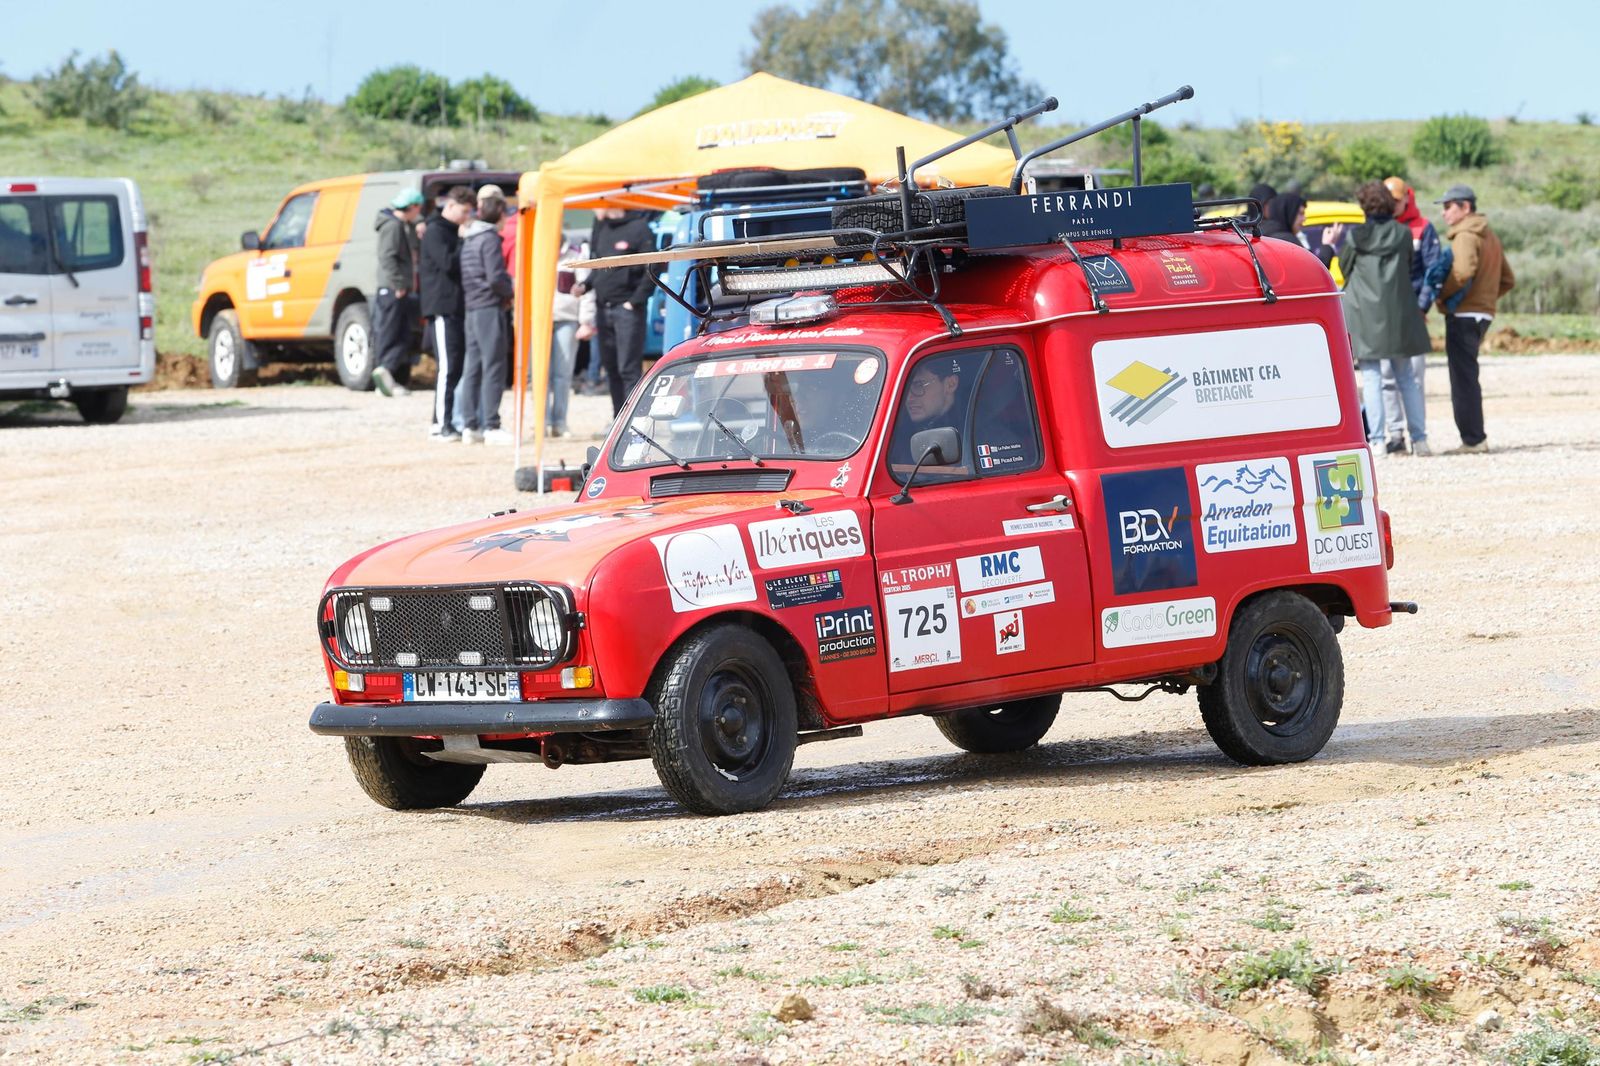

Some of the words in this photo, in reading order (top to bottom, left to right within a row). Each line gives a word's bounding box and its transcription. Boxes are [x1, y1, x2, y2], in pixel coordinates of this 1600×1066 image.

[1031, 190, 1132, 214] FERRANDI
[1072, 217, 1094, 225] PARIS
[1057, 230, 1080, 239] CAMPUS
[1090, 228, 1113, 236] RENNES
[741, 359, 782, 373] TROPHY
[1192, 366, 1255, 387] BÂTIMENT
[1258, 364, 1281, 381] CFA
[653, 376, 671, 395] P
[1195, 383, 1254, 404] BRETAGNE
[814, 515, 834, 527] Les
[1203, 499, 1273, 522] Arradon
[758, 524, 861, 559] Ibériques
[1207, 520, 1291, 549] Equitation
[1314, 537, 1333, 555] DC
[1336, 532, 1373, 552] OUEST
[1123, 540, 1183, 555] FORMATION
[723, 559, 748, 586] Vin
[881, 571, 898, 585] 4L
[900, 563, 952, 583] TROPHY
[980, 551, 1021, 578] RMC
[815, 609, 874, 638] iPrint
[898, 603, 948, 639] 725
[1121, 605, 1214, 632] CadoGreen
[819, 635, 876, 655] production
[819, 653, 840, 661] VANNES
[415, 671, 507, 697] CW-143-SG
[509, 685, 520, 699] 56
